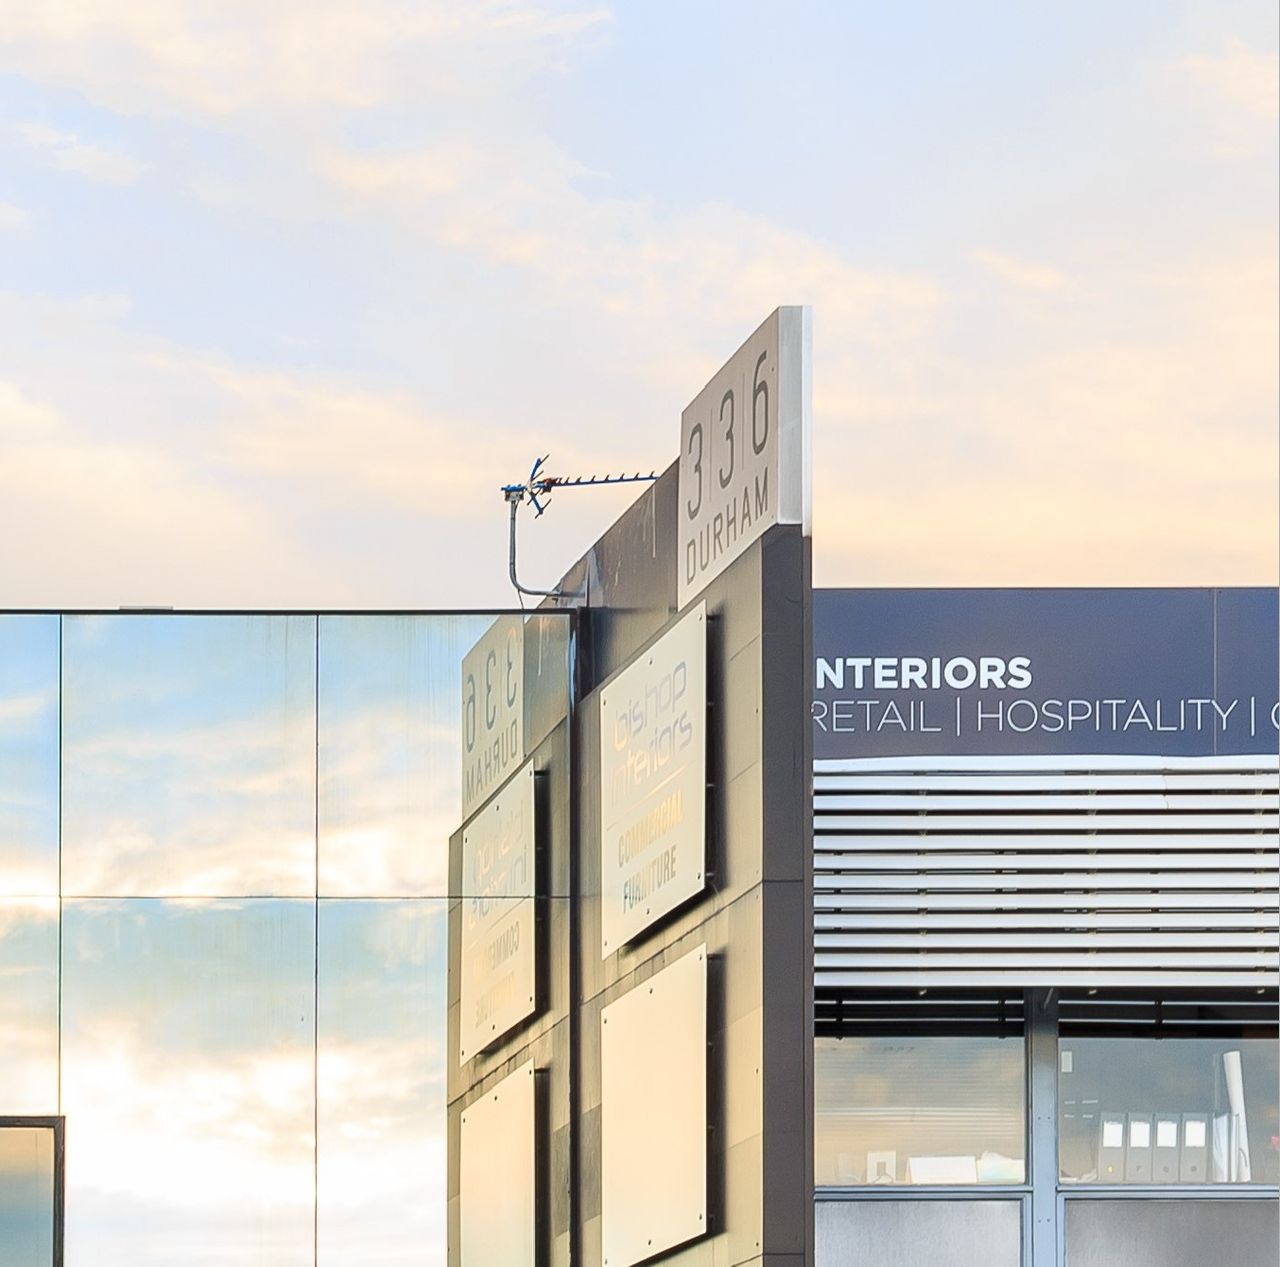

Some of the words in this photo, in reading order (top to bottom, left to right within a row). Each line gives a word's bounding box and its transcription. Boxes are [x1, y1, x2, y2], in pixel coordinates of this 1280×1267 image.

[685, 466, 769, 586] DURHAM
[816, 655, 1033, 690] NTERIORS
[977, 699, 1239, 733] HOSPITALITY
[618, 788, 685, 869] COMMERCIAL
[623, 844, 677, 914] FURNITURE
